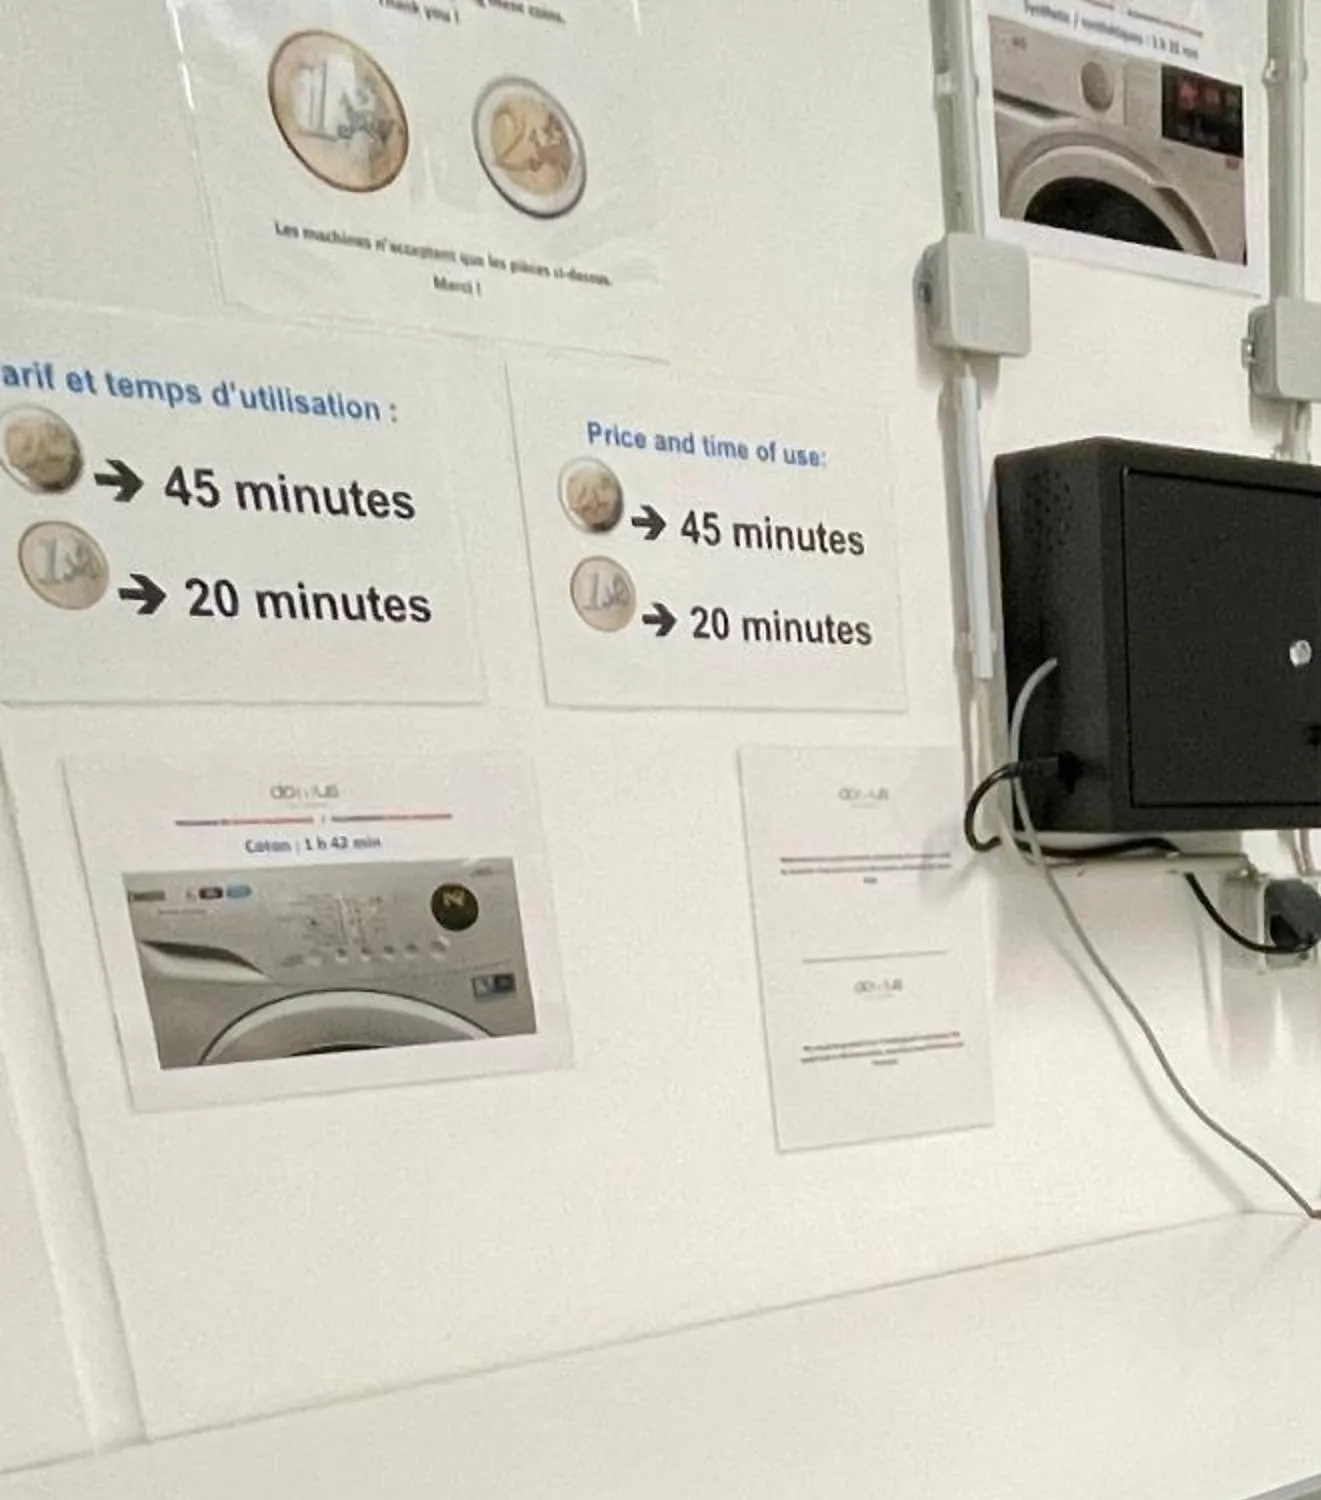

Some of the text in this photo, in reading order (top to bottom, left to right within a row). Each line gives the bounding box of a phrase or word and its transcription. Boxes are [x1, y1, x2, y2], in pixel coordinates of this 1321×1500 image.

[275, 221, 299, 239] Les
[302, 226, 372, 250] machines
[460, 252, 485, 268] que
[487, 249, 507, 271] les
[433, 274, 474, 297] Merci
[2, 361, 54, 390] arif
[66, 370, 98, 396] et
[105, 373, 202, 409] temps
[212, 380, 383, 422] d'utilisation
[587, 420, 827, 468] Price and time of use:
[164, 465, 416, 520] 45 minutes
[680, 509, 866, 556] 45 minutes
[184, 577, 432, 624] 20 minutes
[689, 605, 874, 646] 20 minutes
